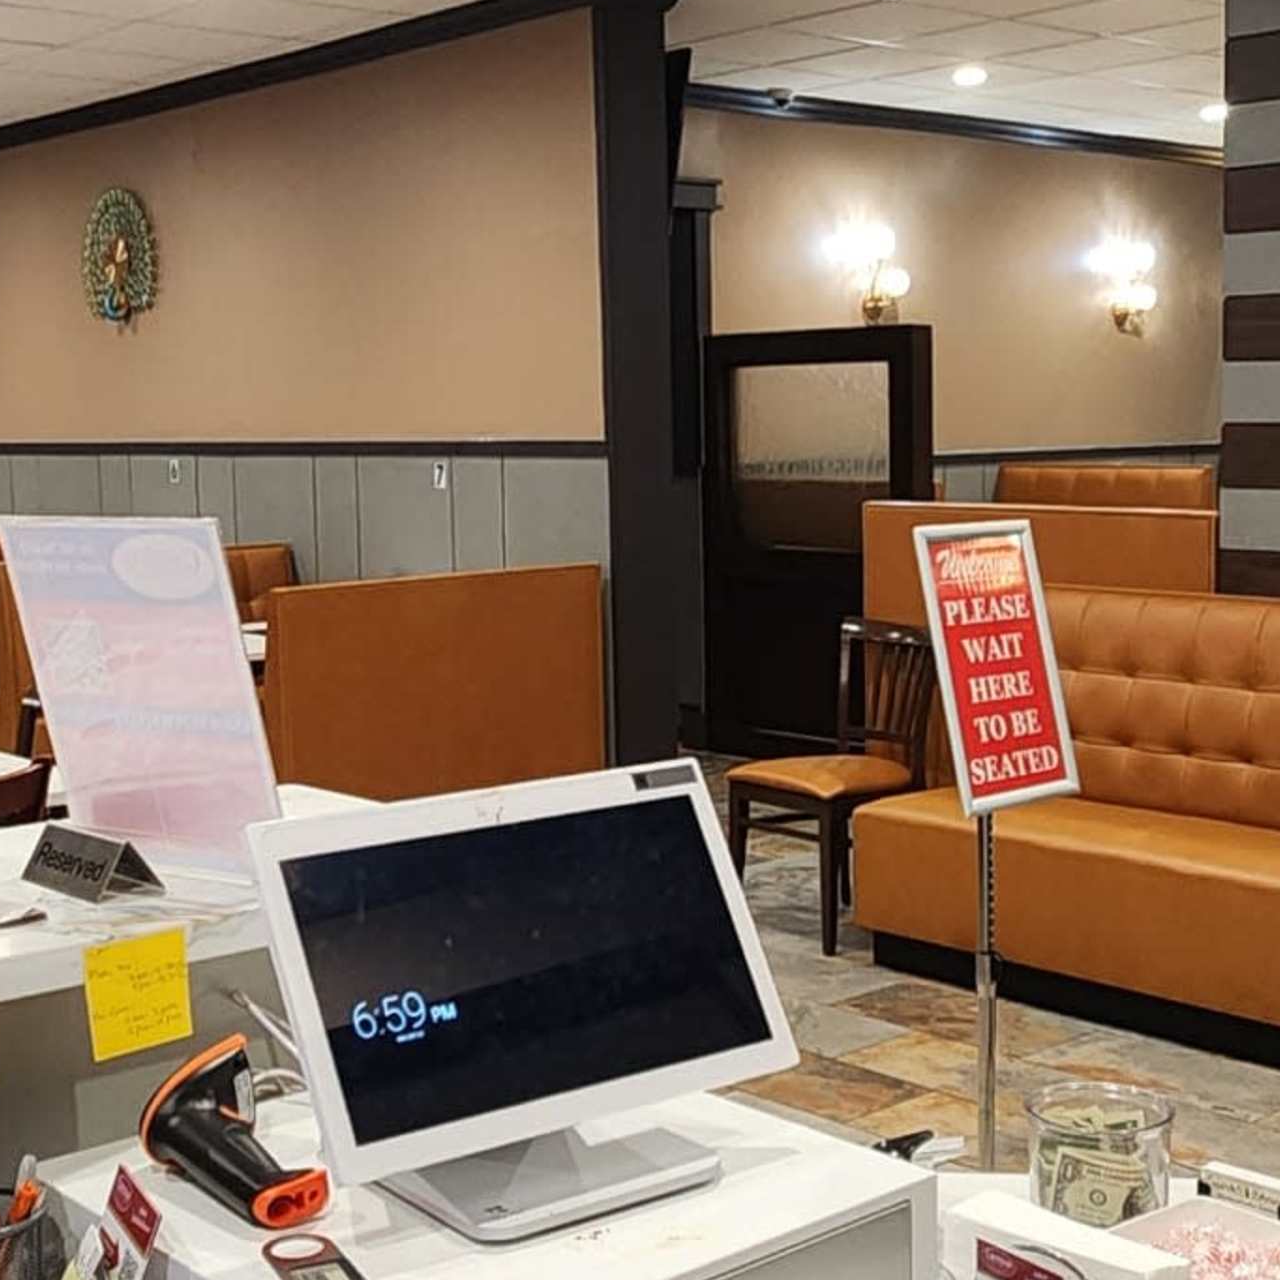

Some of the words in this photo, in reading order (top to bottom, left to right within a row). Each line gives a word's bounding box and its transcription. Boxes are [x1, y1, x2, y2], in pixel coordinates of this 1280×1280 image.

[942, 593, 1030, 627] PLEASE
[961, 632, 1024, 664] WAIT
[968, 671, 1034, 705] HERE
[974, 714, 1007, 745] TO
[1011, 708, 1042, 738] BE
[970, 745, 1060, 786] SEATED
[35, 841, 110, 882] Reserved
[352, 990, 427, 1040] 6:59
[430, 1002, 458, 1023] PM
